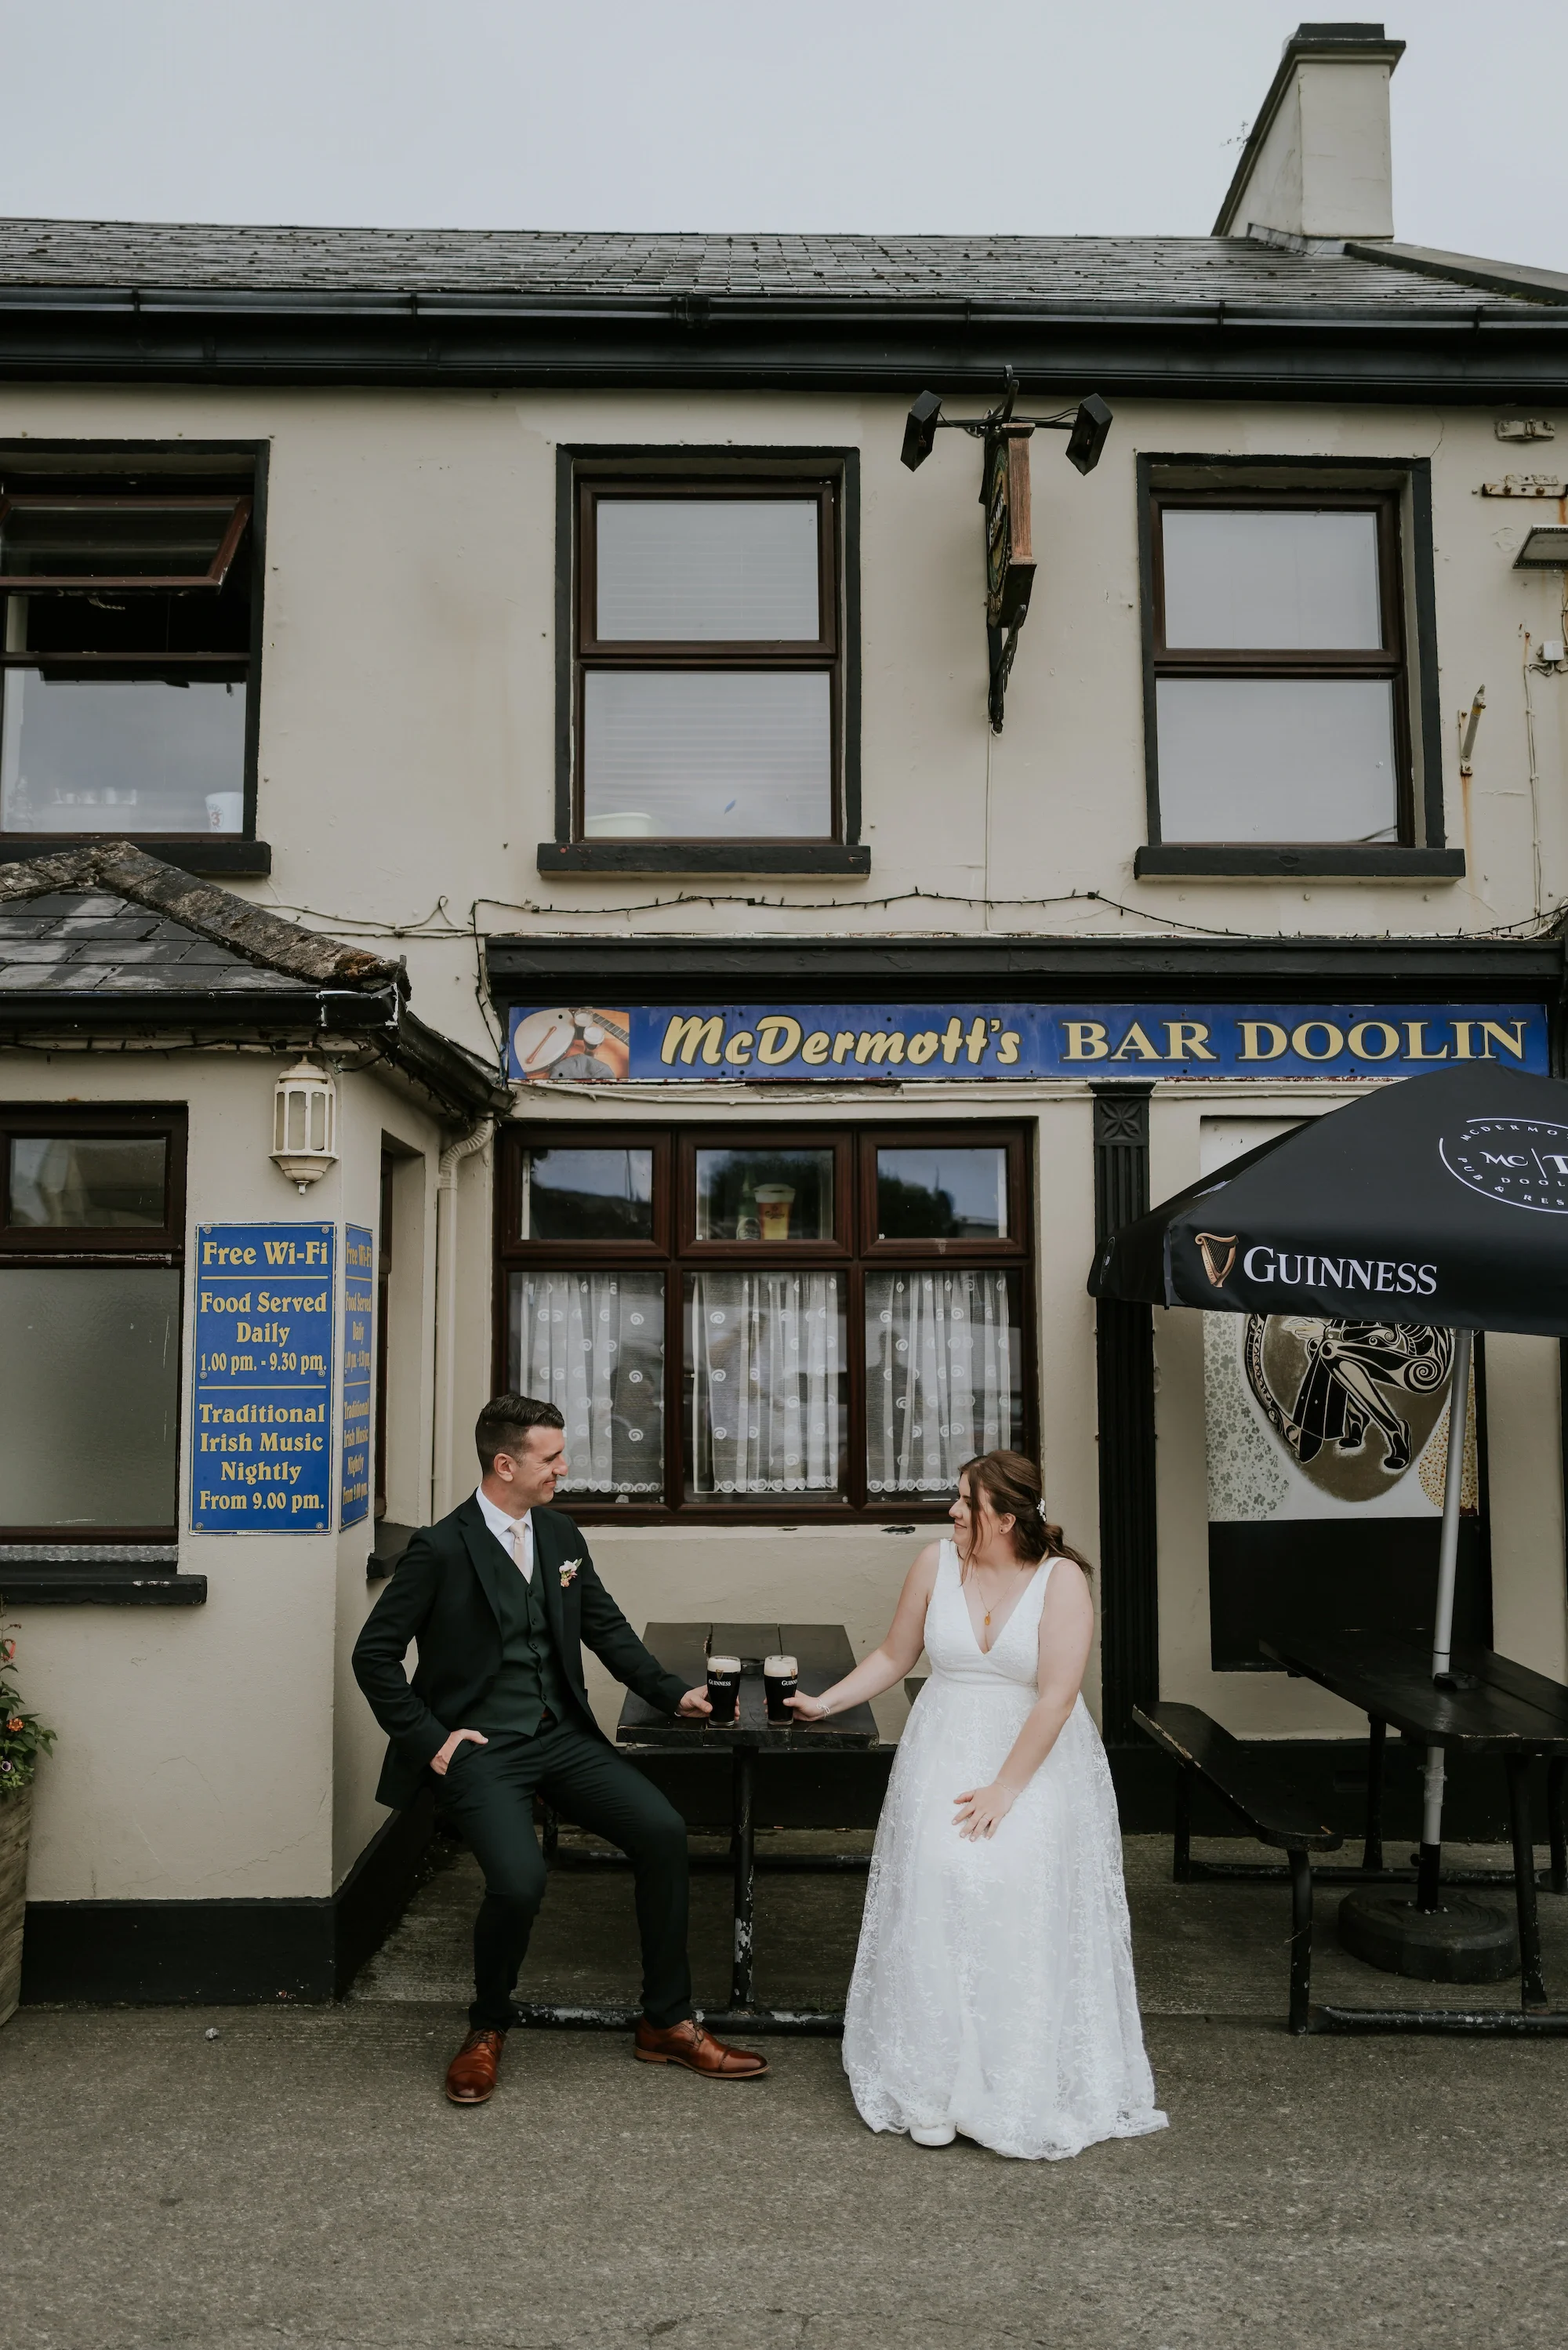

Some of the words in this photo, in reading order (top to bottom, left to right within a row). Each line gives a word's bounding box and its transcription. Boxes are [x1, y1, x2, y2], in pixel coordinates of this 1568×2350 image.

[660, 1015, 1022, 1066] McDermott's
[1064, 1021, 1215, 1059] BAR
[1239, 1021, 1526, 1059] DOOLIN
[1460, 1124, 1568, 1142] MCDERMO
[1457, 1157, 1483, 1181] PUB
[202, 1242, 256, 1265] Free
[263, 1242, 328, 1265] Wi-Fi
[346, 1241, 358, 1266] Free
[358, 1244, 372, 1267] Wi-Fi
[1243, 1246, 1437, 1295] GUINNESS
[201, 1291, 251, 1313] Food
[256, 1291, 327, 1313] Served
[346, 1291, 357, 1311] Food
[357, 1291, 371, 1313] Served
[237, 1321, 290, 1347] Daily
[353, 1320, 364, 1345] Daily
[201, 1353, 227, 1371] 1.00
[230, 1355, 257, 1375] pm.
[269, 1352, 297, 1371] 9.30
[300, 1355, 327, 1376] pm.
[198, 1404, 325, 1423] Traditional
[344, 1398, 369, 1420] Traditional
[200, 1433, 252, 1452] Irish
[260, 1433, 323, 1451] Music
[343, 1429, 355, 1448] Irish
[356, 1426, 368, 1445] Music
[221, 1461, 302, 1485] Nightly
[347, 1453, 364, 1477] Nightly
[200, 1491, 247, 1509] From
[252, 1492, 287, 1510] 9.00
[292, 1494, 325, 1513] pm.
[343, 1486, 354, 1506] From
